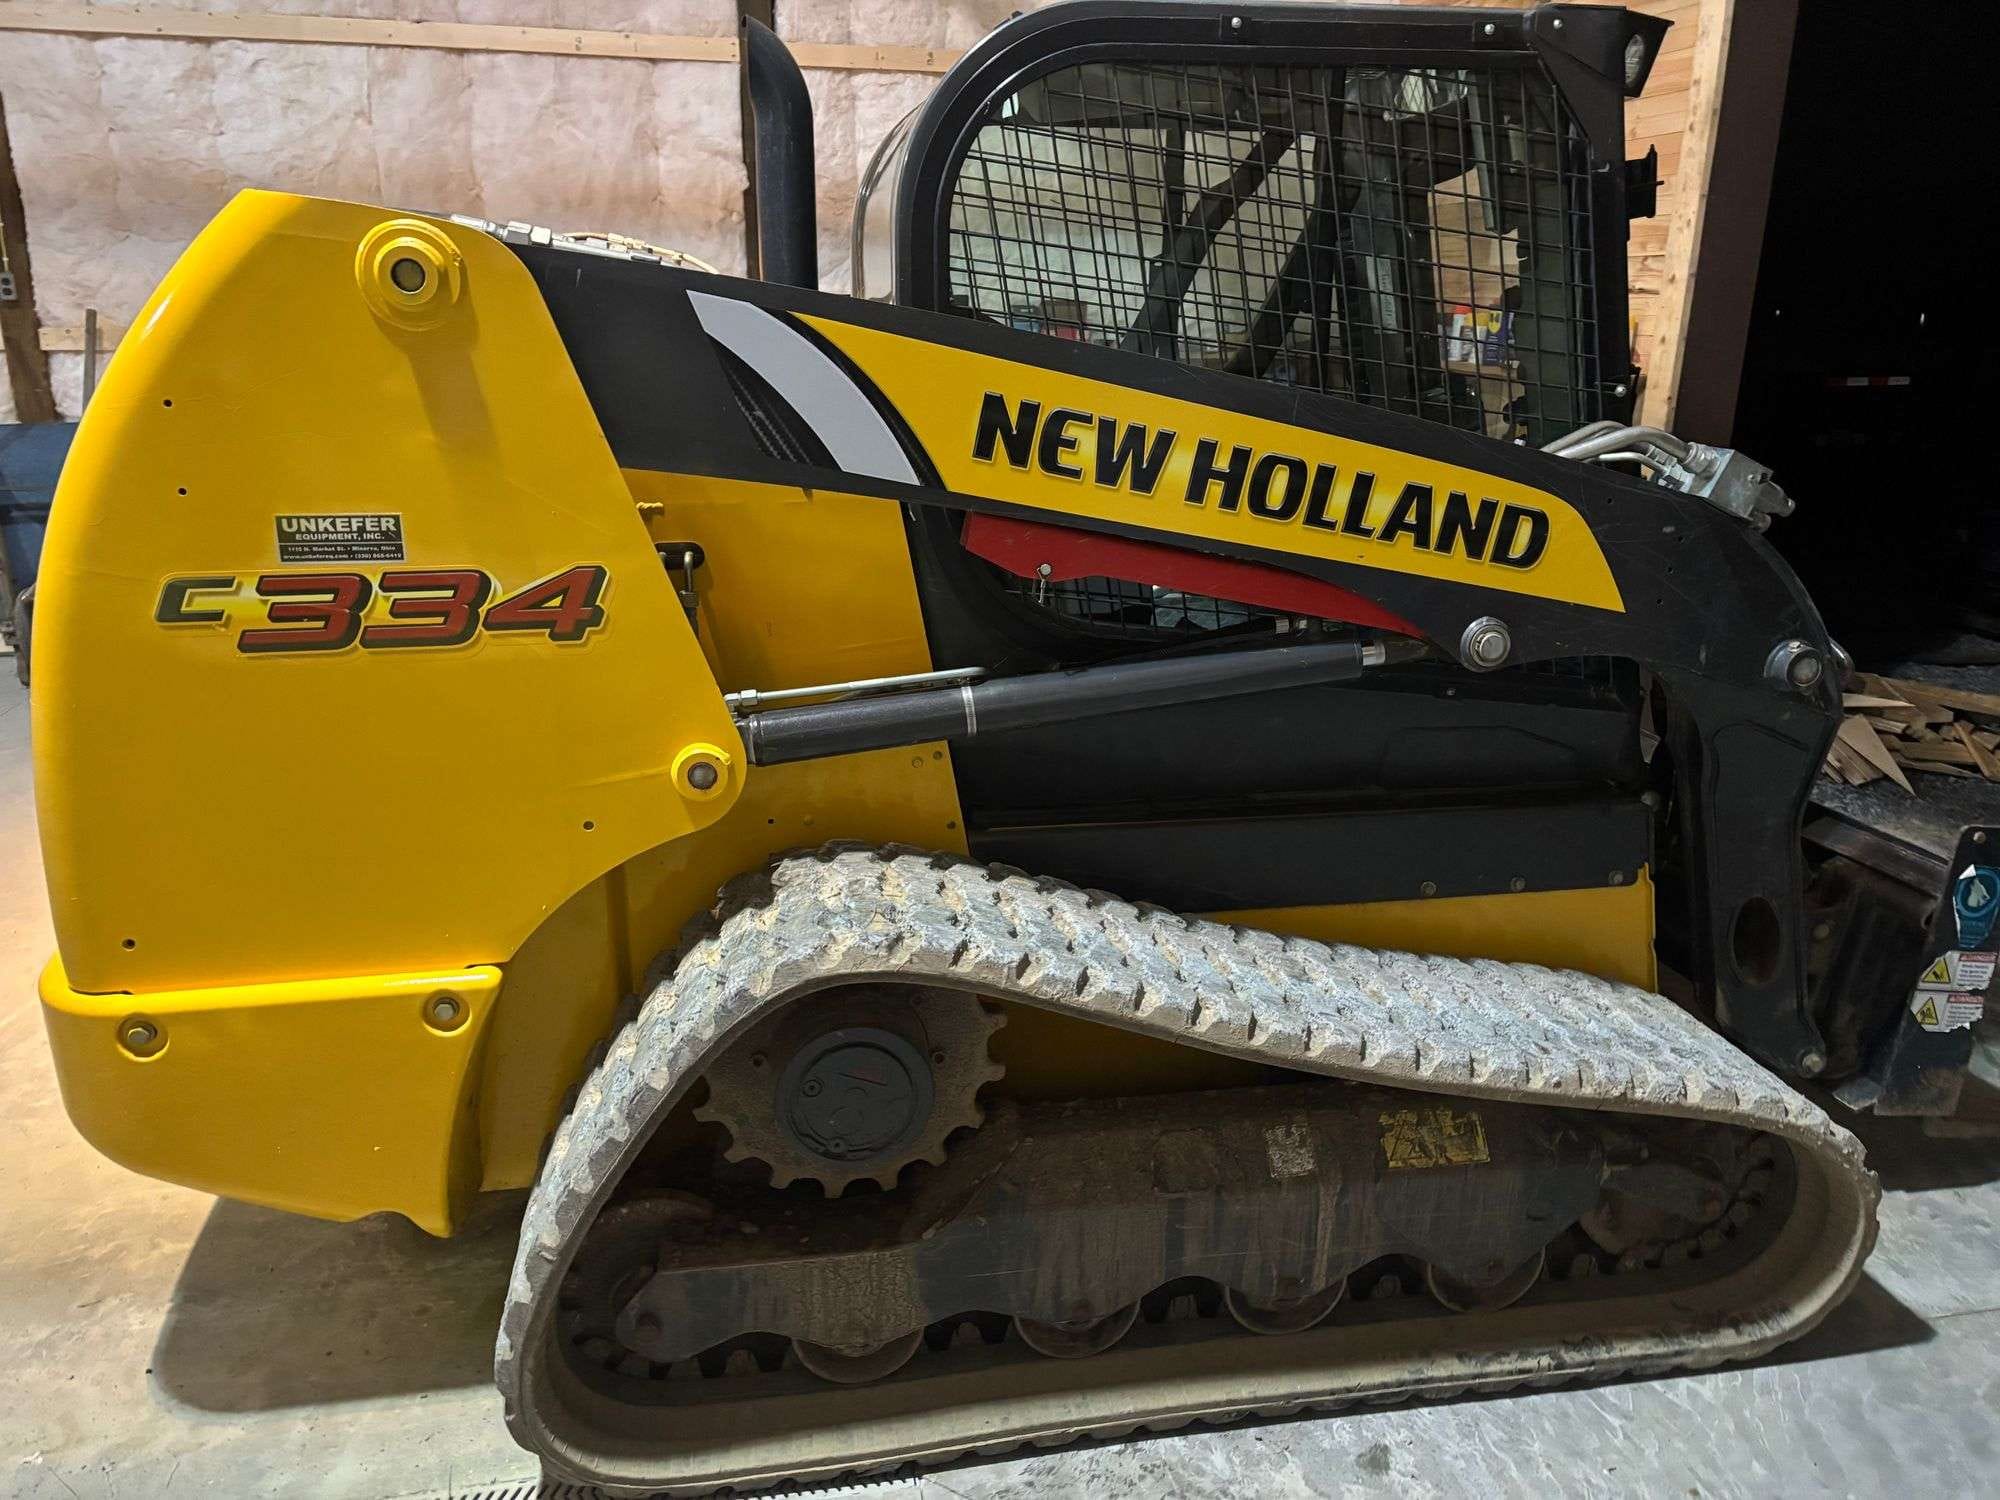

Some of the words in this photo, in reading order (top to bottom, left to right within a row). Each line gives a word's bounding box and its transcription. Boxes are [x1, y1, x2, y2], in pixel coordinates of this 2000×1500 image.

[971, 391, 1177, 497] NEW
[1183, 437, 1551, 570] HOLLAND
[281, 517, 397, 532] UNKEFER
[296, 532, 361, 541] EQUIPMENT,
[364, 532, 385, 540] INC.
[156, 566, 606, 653] C334
